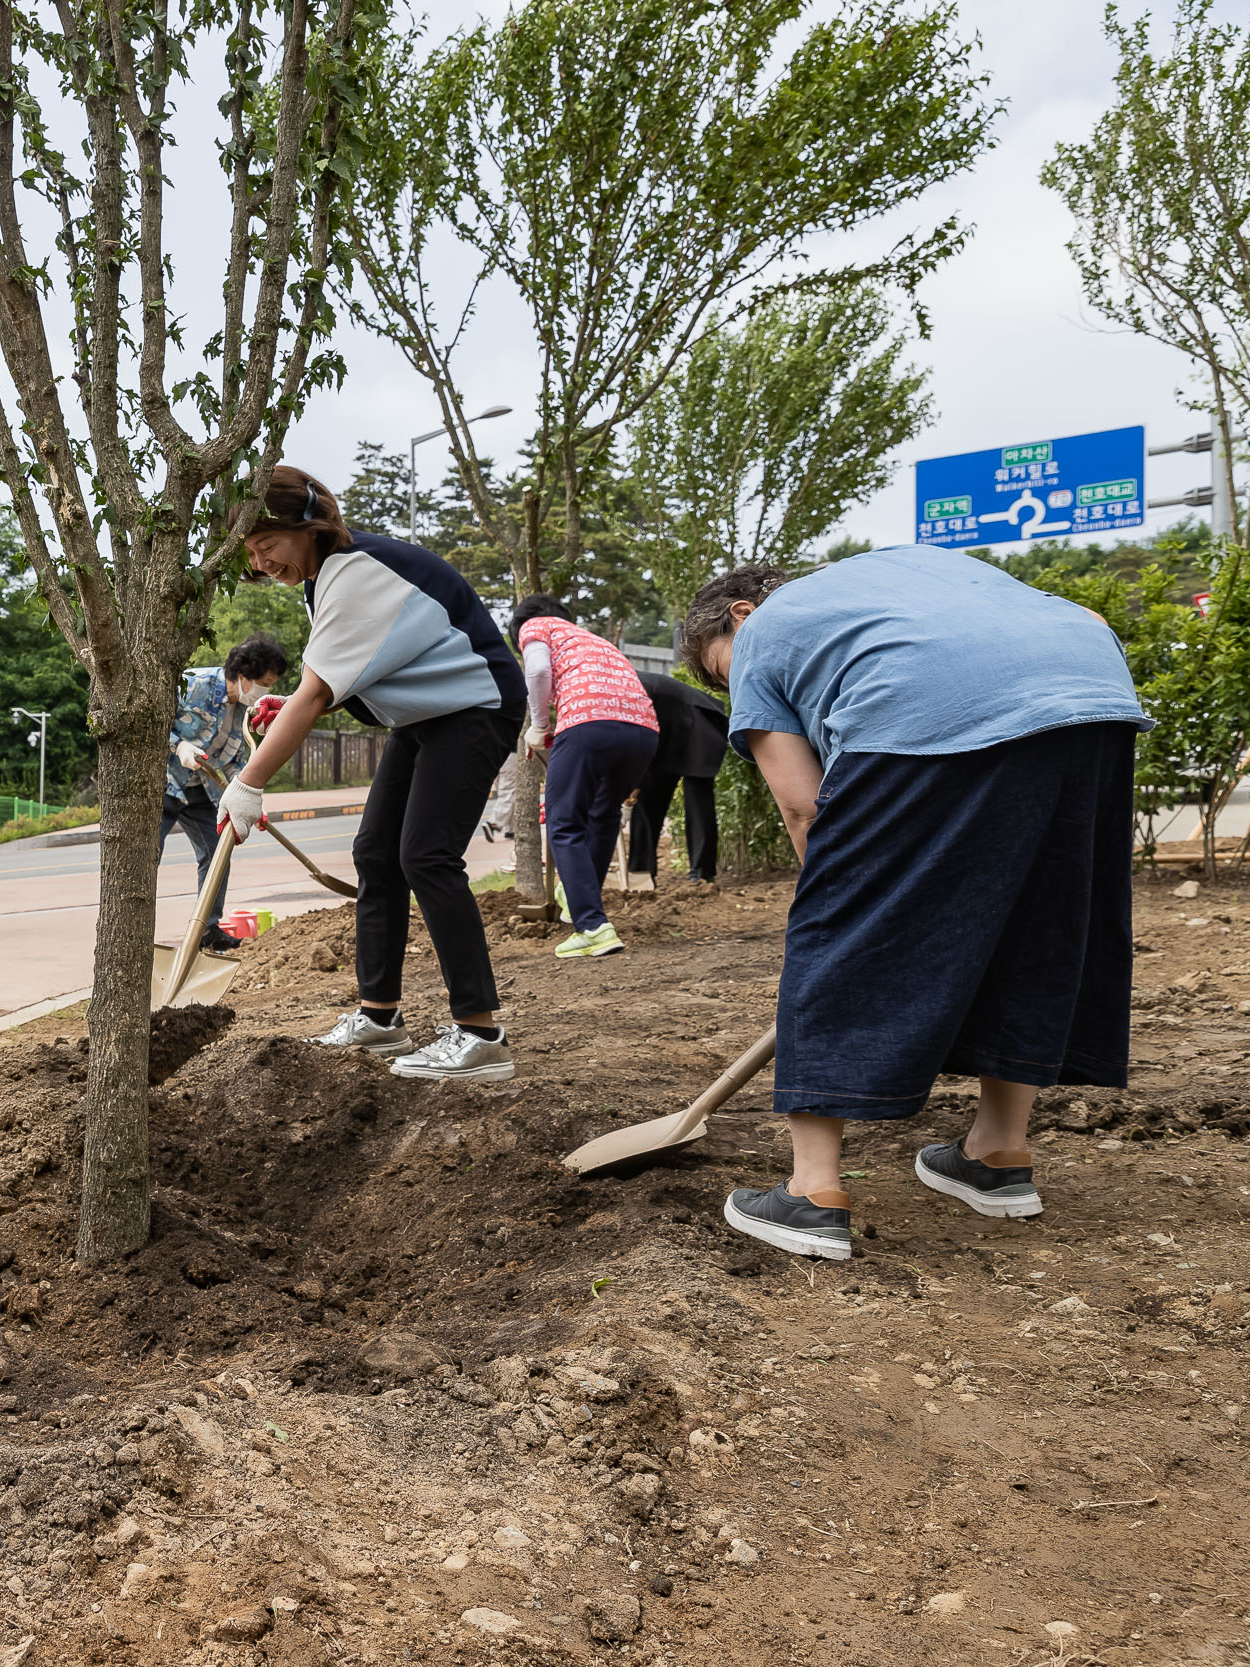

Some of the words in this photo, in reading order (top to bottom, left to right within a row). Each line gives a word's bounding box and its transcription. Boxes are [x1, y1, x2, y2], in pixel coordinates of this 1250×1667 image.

[1005, 445, 1048, 462] 아차산
[994, 461, 1060, 482] 워커힐로
[1080, 482, 1134, 503] 천호대교
[928, 499, 968, 517] 군자역
[1072, 500, 1141, 523] 천호대로
[918, 516, 979, 538] 천호대로
